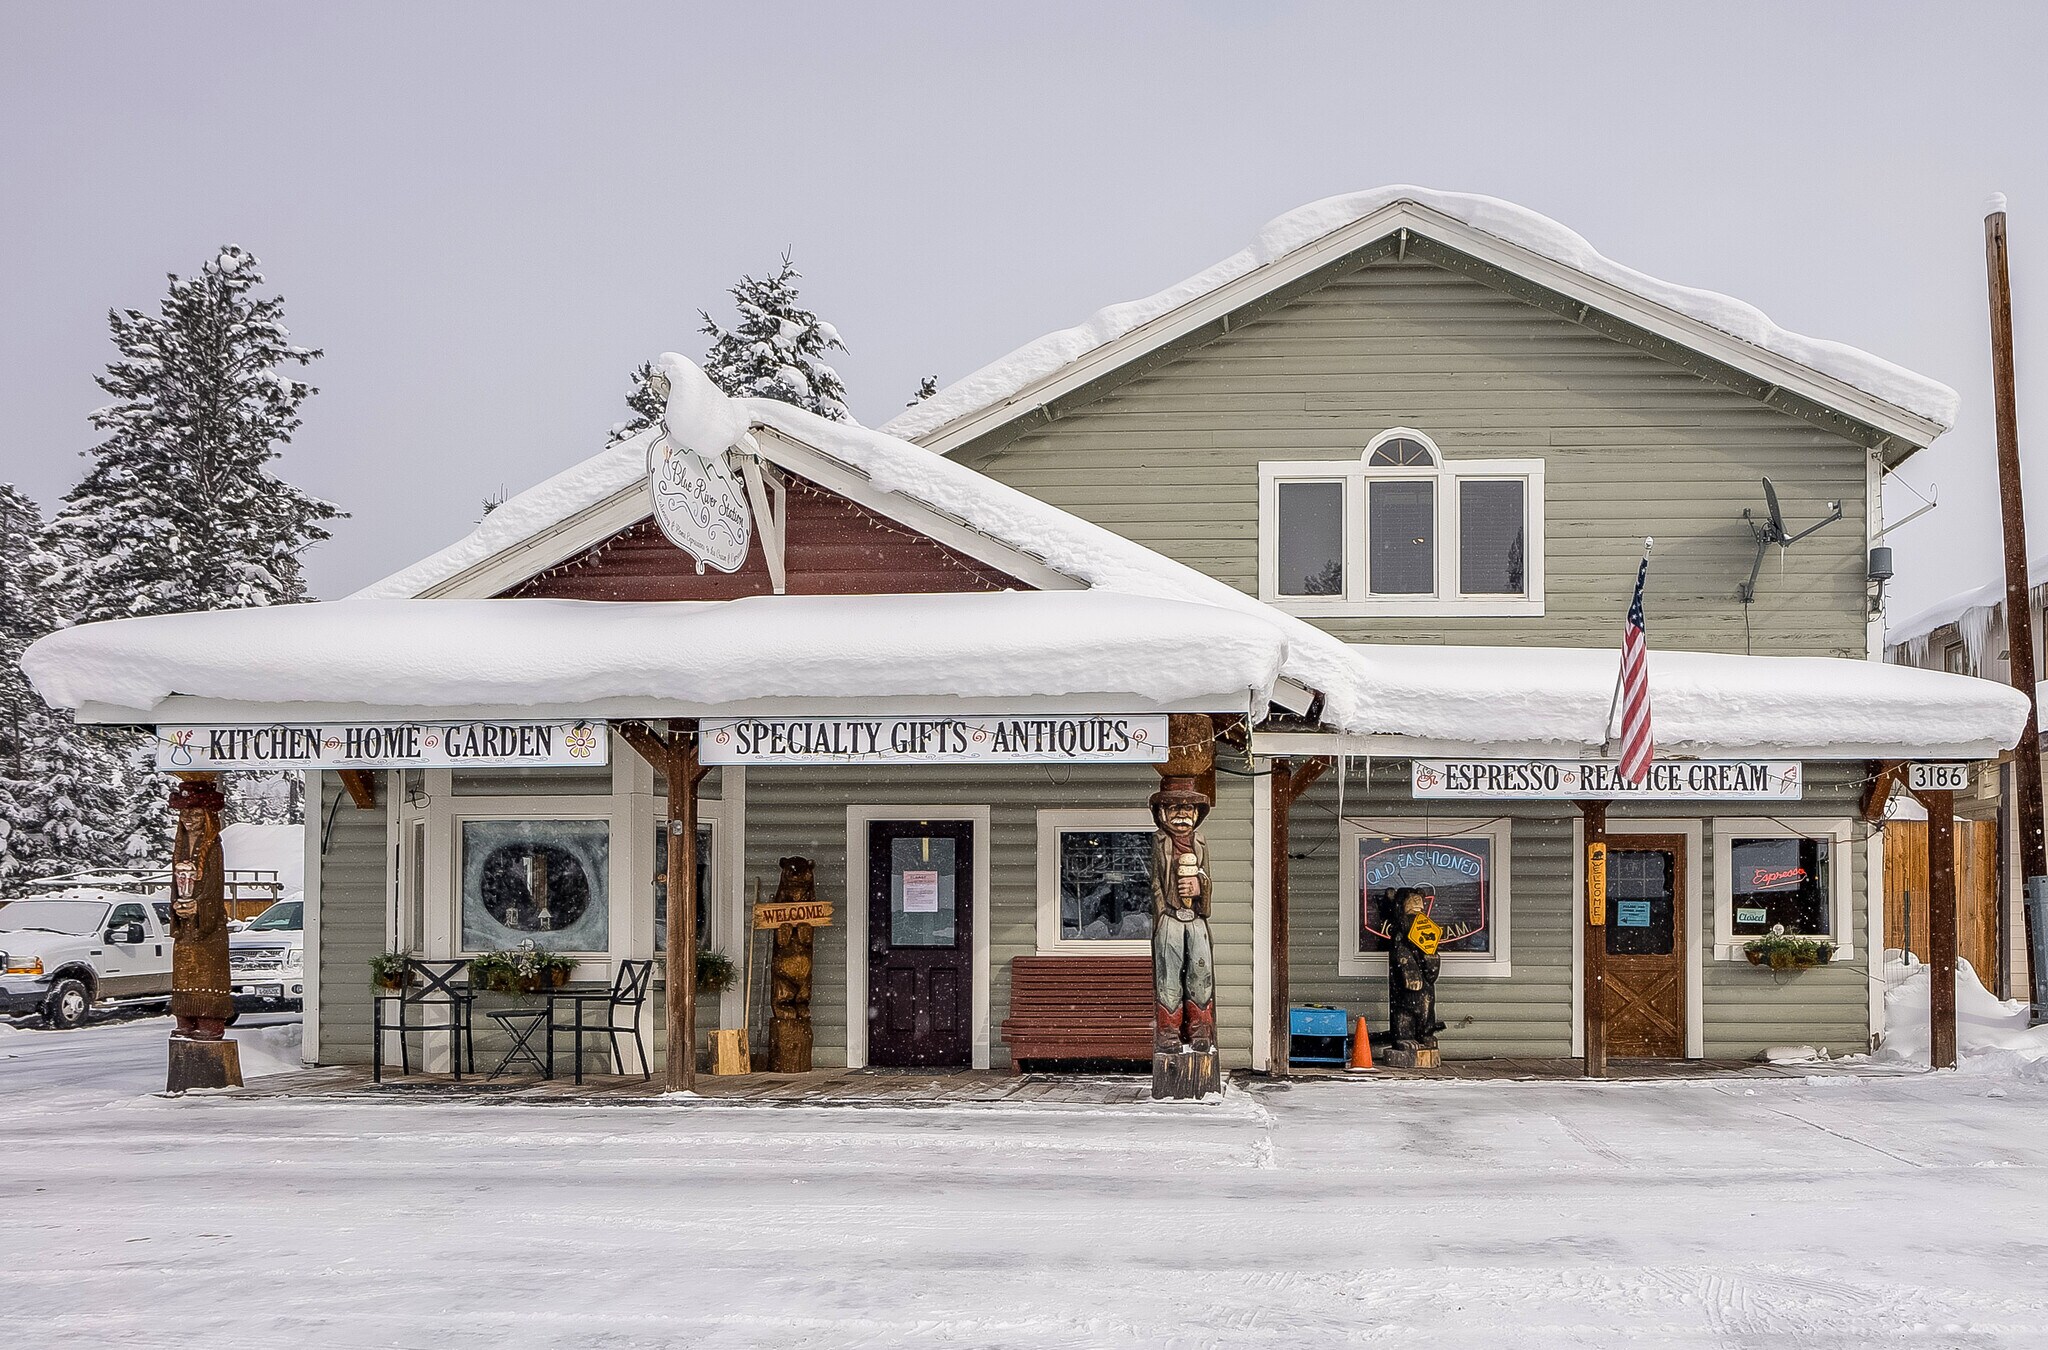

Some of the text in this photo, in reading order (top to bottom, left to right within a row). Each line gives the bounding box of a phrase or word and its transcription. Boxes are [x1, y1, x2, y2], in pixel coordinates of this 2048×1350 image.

[671, 460, 744, 528] Blue River Station
[209, 725, 553, 760] KITCHEN HOME GARDEN
[735, 719, 1130, 757] SPECIALTY GIFTS ANTIQUES
[1445, 764, 1559, 791] ESPRESSO
[1646, 764, 1682, 791] ICE
[1688, 764, 1769, 791] CREAM
[1914, 766, 1962, 787] 3186
[1366, 850, 1481, 885] OLD FASHIONED
[1752, 867, 1808, 888] Espresso
[1592, 861, 1603, 917] WELCOME
[763, 904, 825, 923] WELCOME
[1738, 912, 1765, 922] Closed
